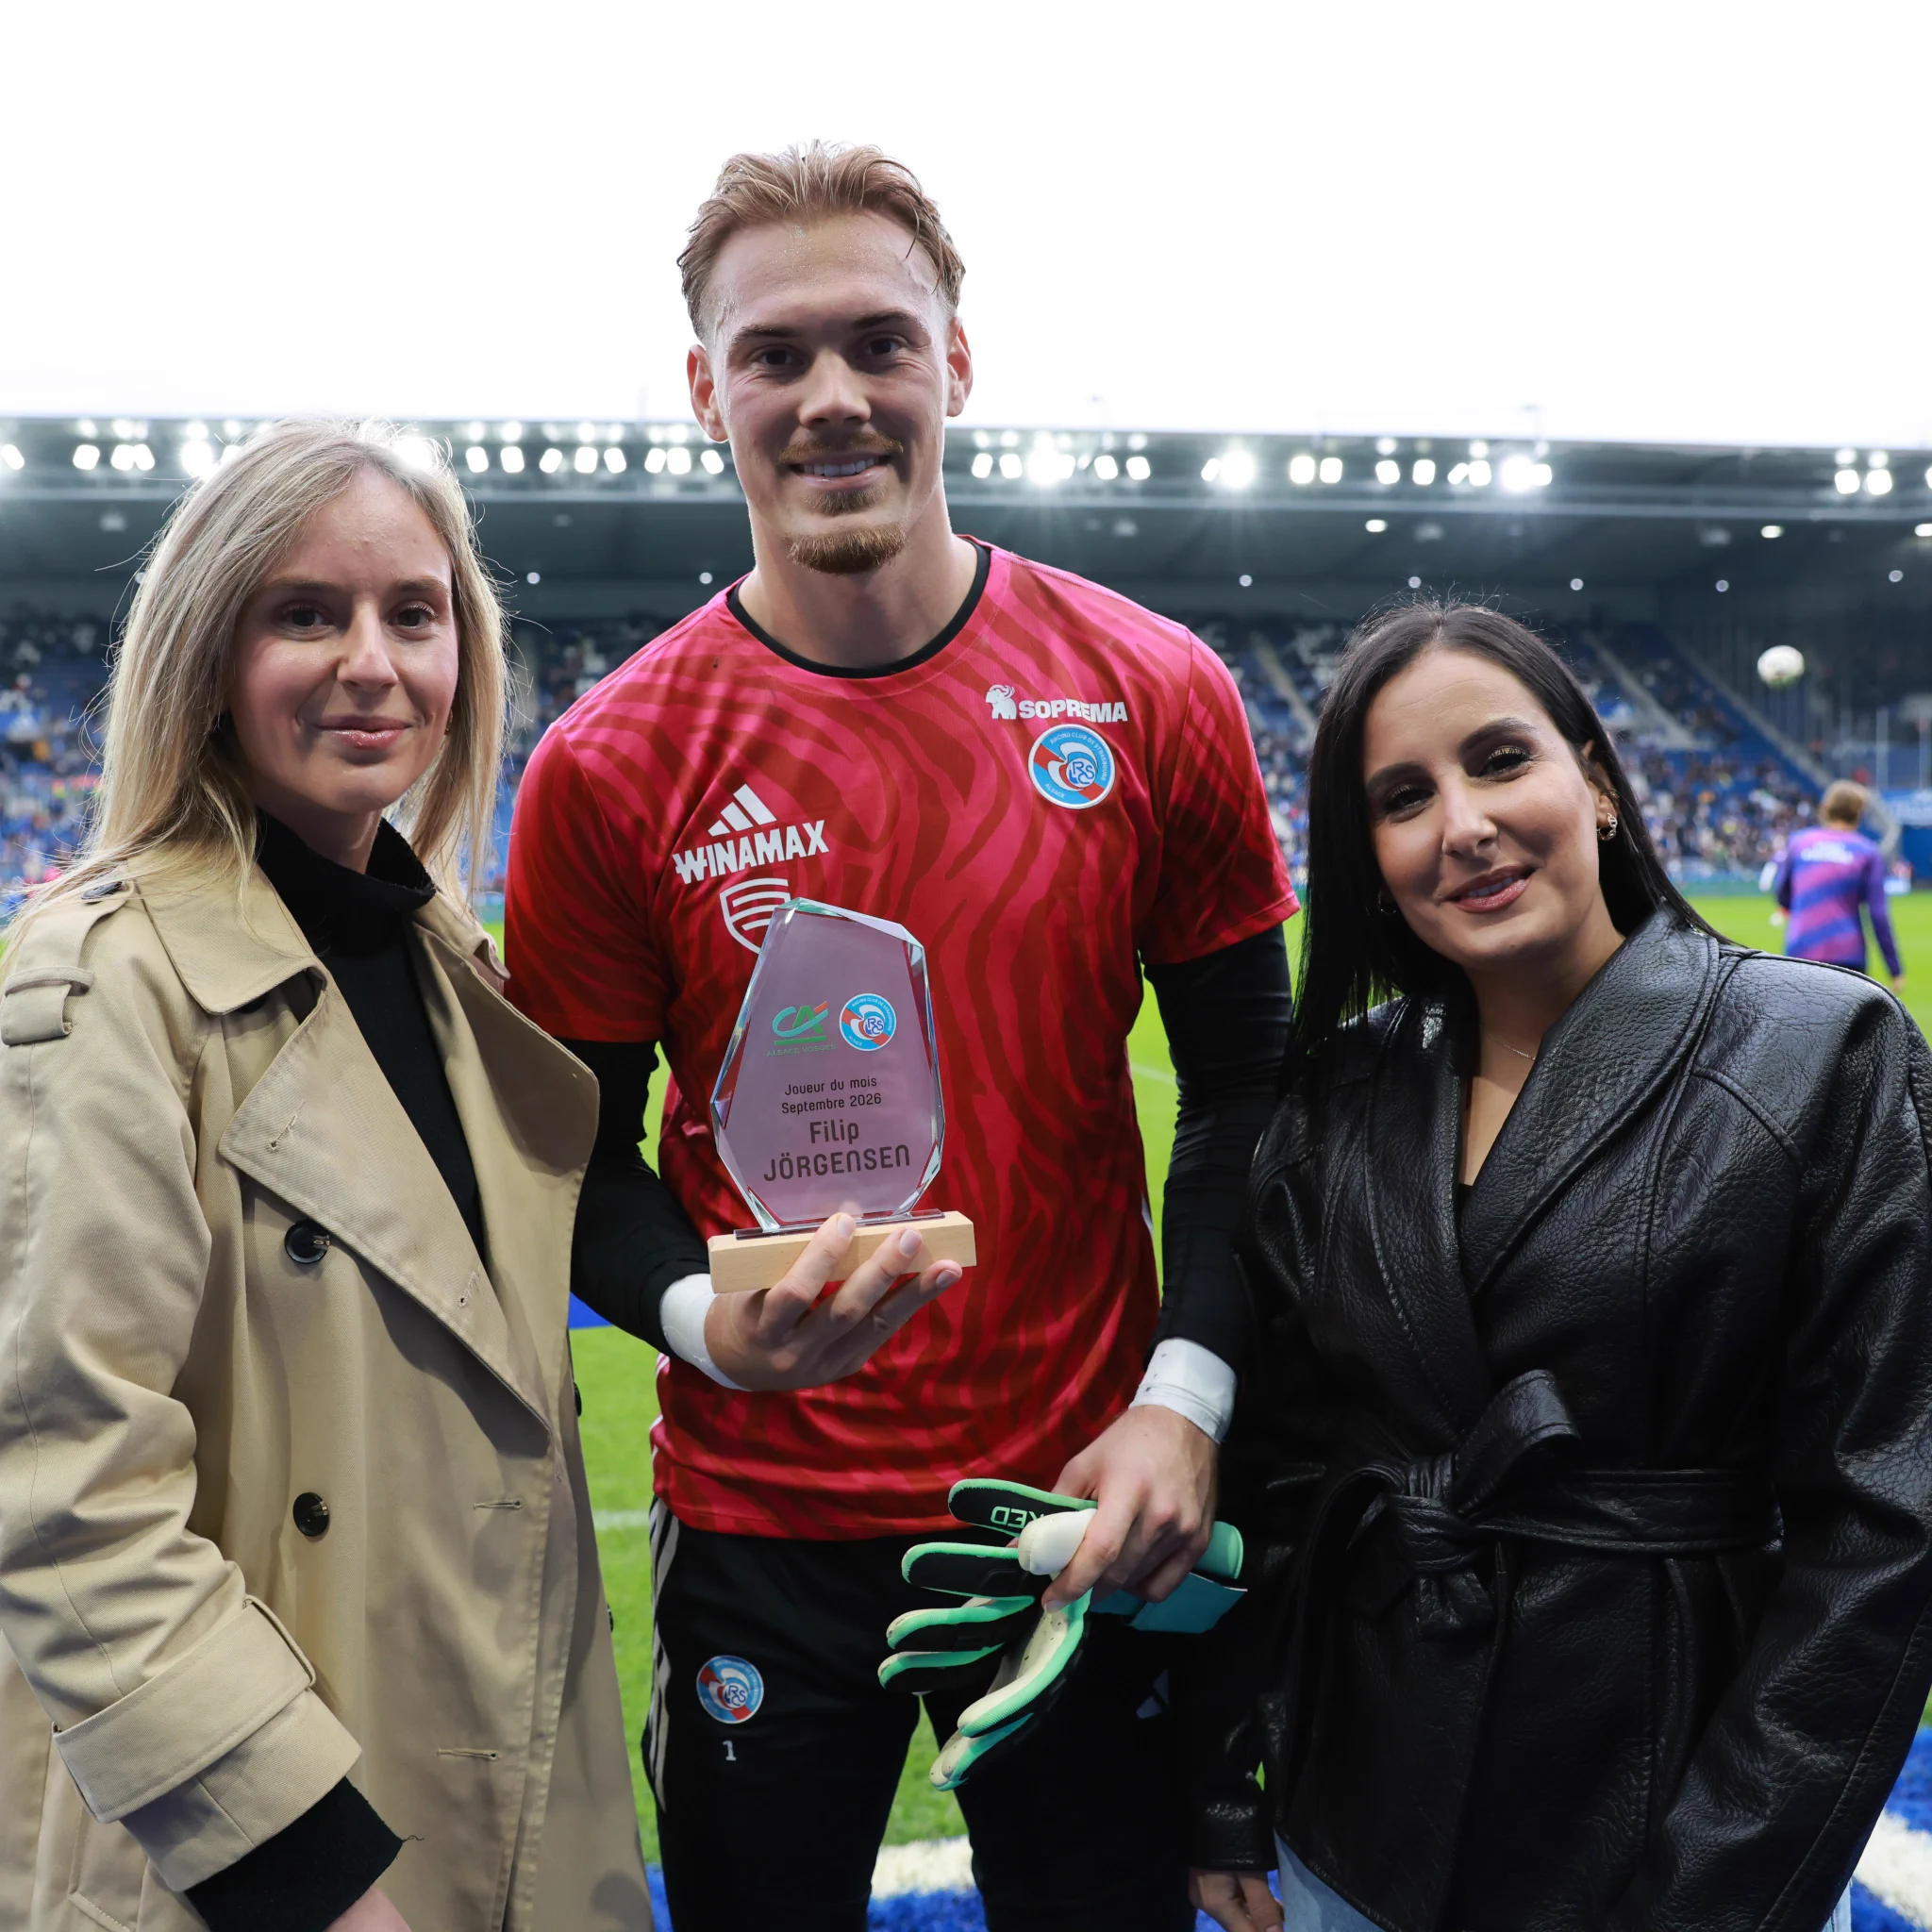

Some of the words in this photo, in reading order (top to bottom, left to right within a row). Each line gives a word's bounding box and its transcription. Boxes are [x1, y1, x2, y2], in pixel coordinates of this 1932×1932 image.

[1019, 699, 1128, 723] SOPREMA
[1049, 732, 1071, 744] RACING
[672, 820, 829, 885] WINAMAX
[767, 1047, 800, 1057] ALSACE
[802, 1044, 837, 1053] VOSGES
[785, 1083, 825, 1096] Joueur
[830, 1079, 844, 1091] du
[850, 1076, 877, 1089] mois
[781, 1098, 845, 1115] Septembre
[850, 1092, 882, 1108] 2026
[809, 1119, 859, 1144] Filip
[763, 1144, 910, 1181] JÖRGENSEN
[722, 1740, 737, 1761] 1
